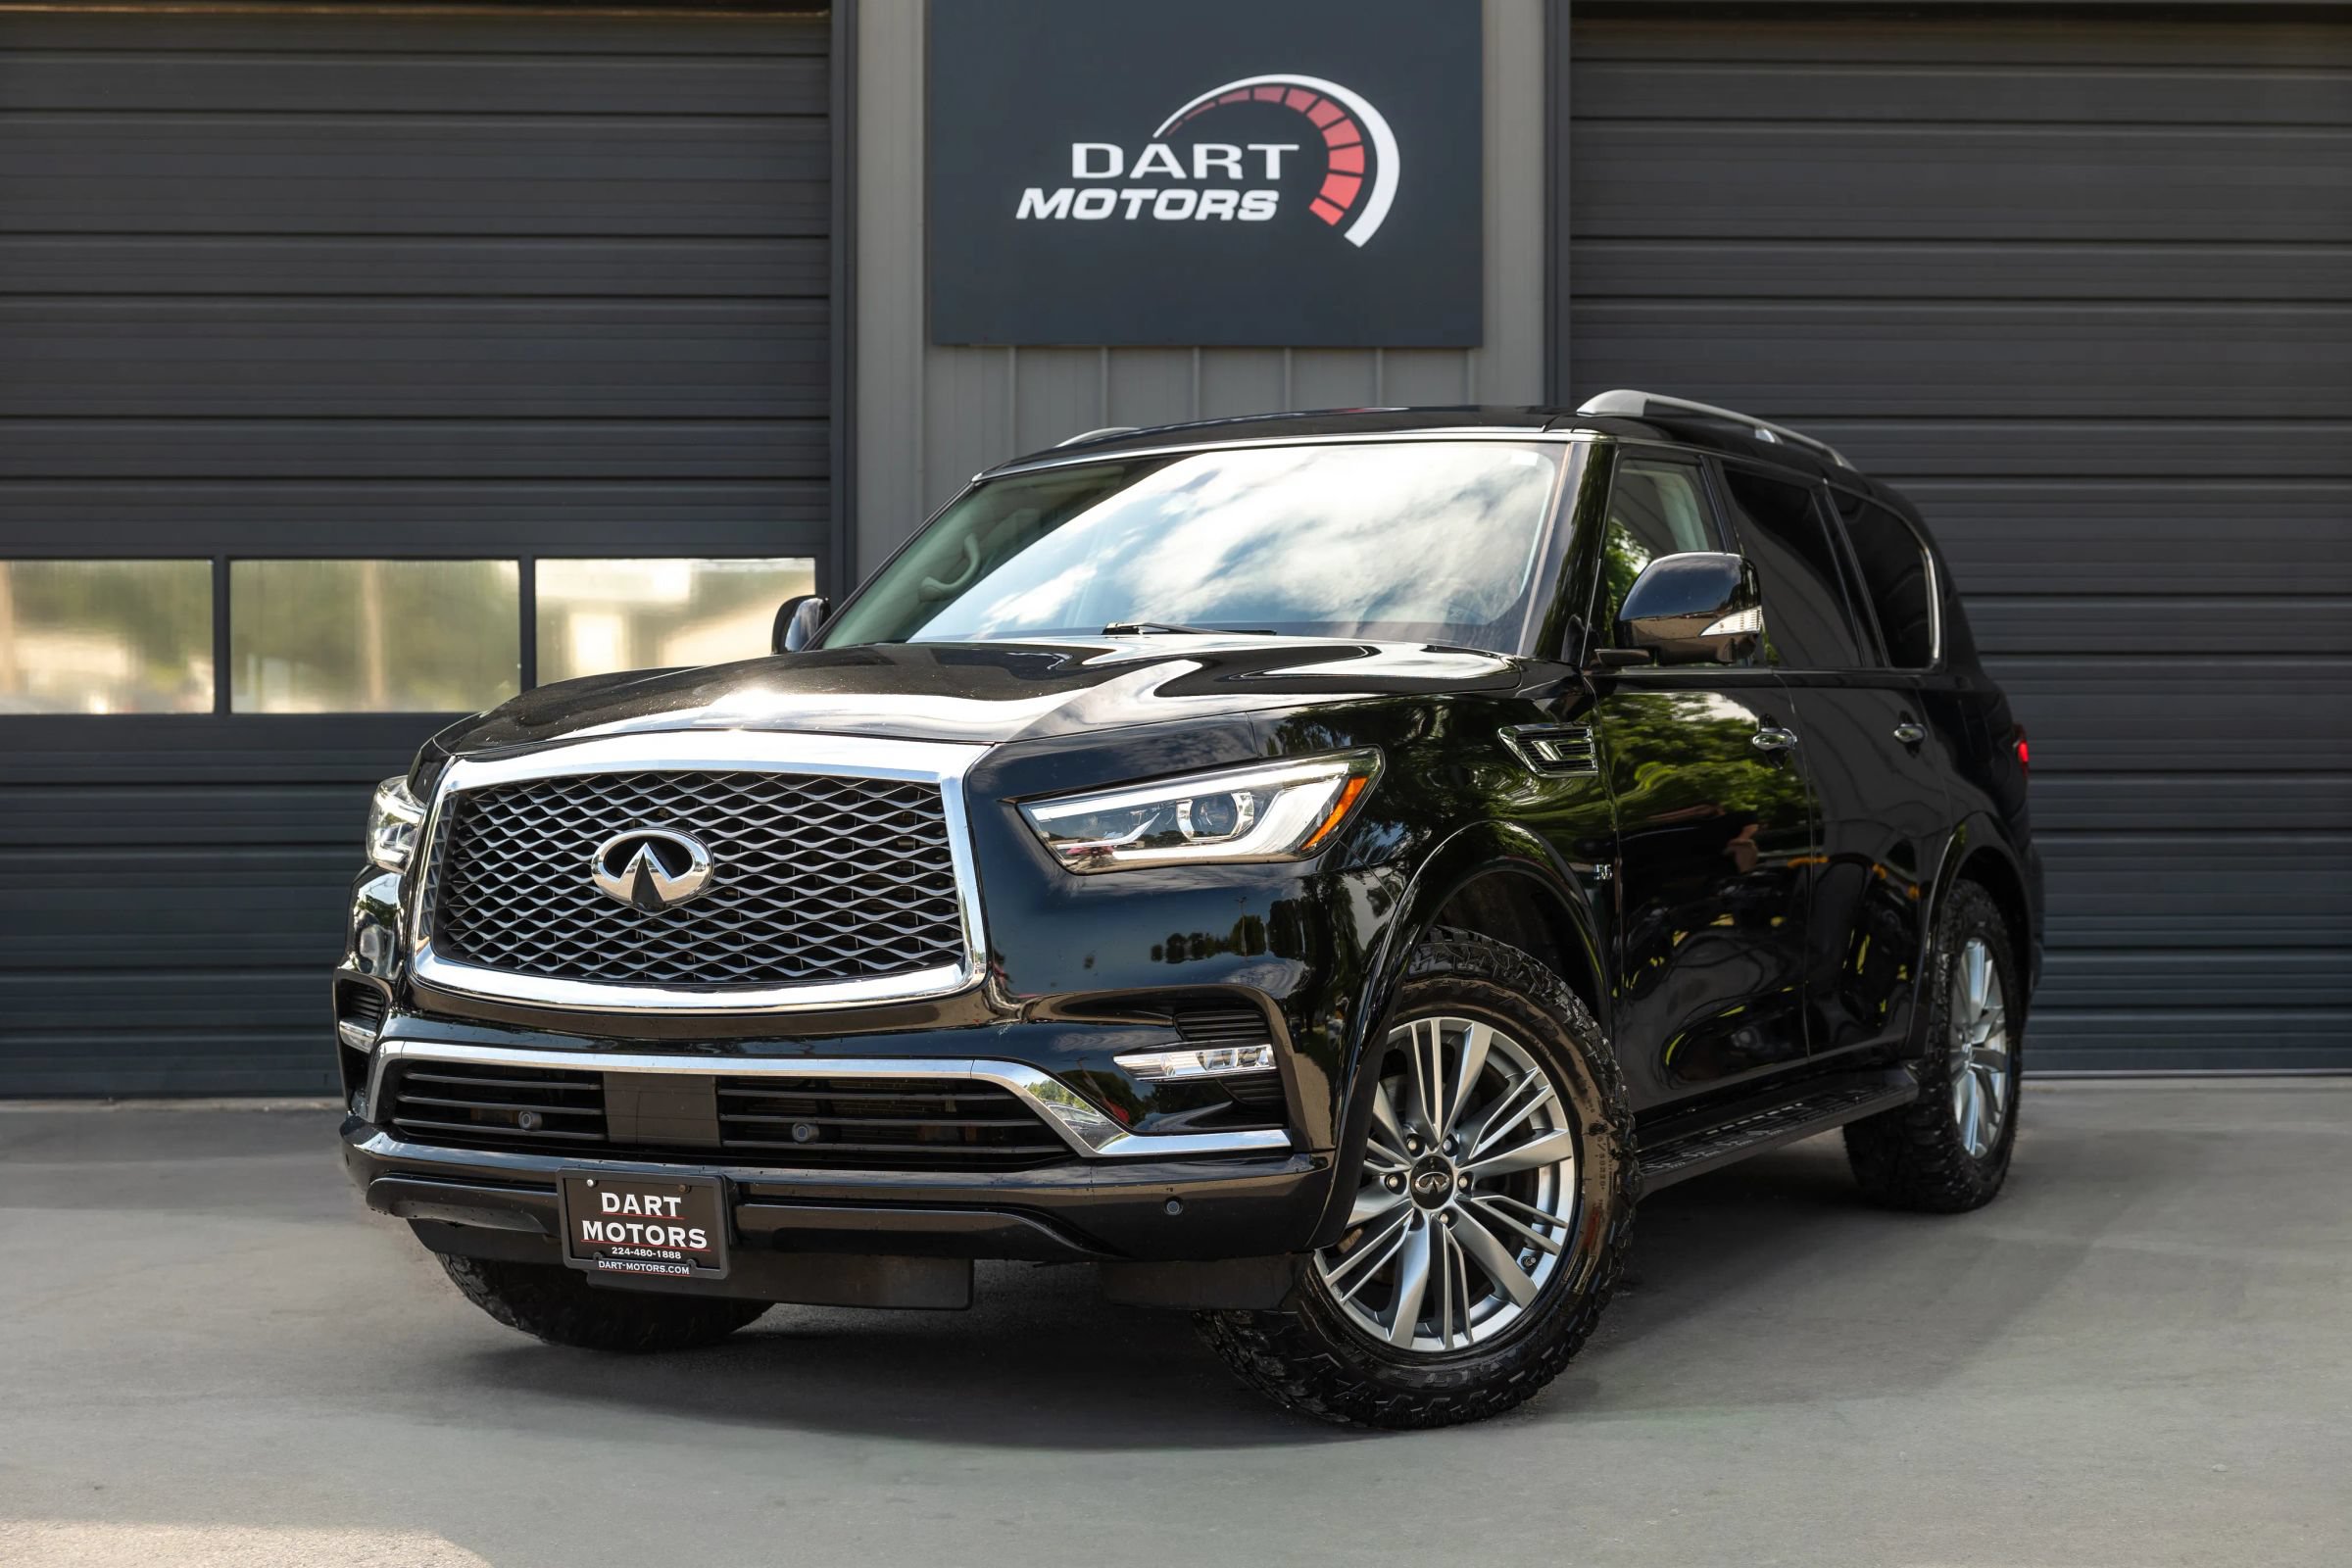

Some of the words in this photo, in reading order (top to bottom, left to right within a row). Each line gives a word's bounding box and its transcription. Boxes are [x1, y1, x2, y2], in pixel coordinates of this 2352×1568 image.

[1071, 143, 1299, 179] DART
[1015, 187, 1280, 221] MOTORS
[601, 1192, 681, 1217] DART
[582, 1220, 708, 1250] MOTORS
[612, 1247, 682, 1259] 224-480-1888
[599, 1260, 690, 1275] DART-MOTORS.COM
